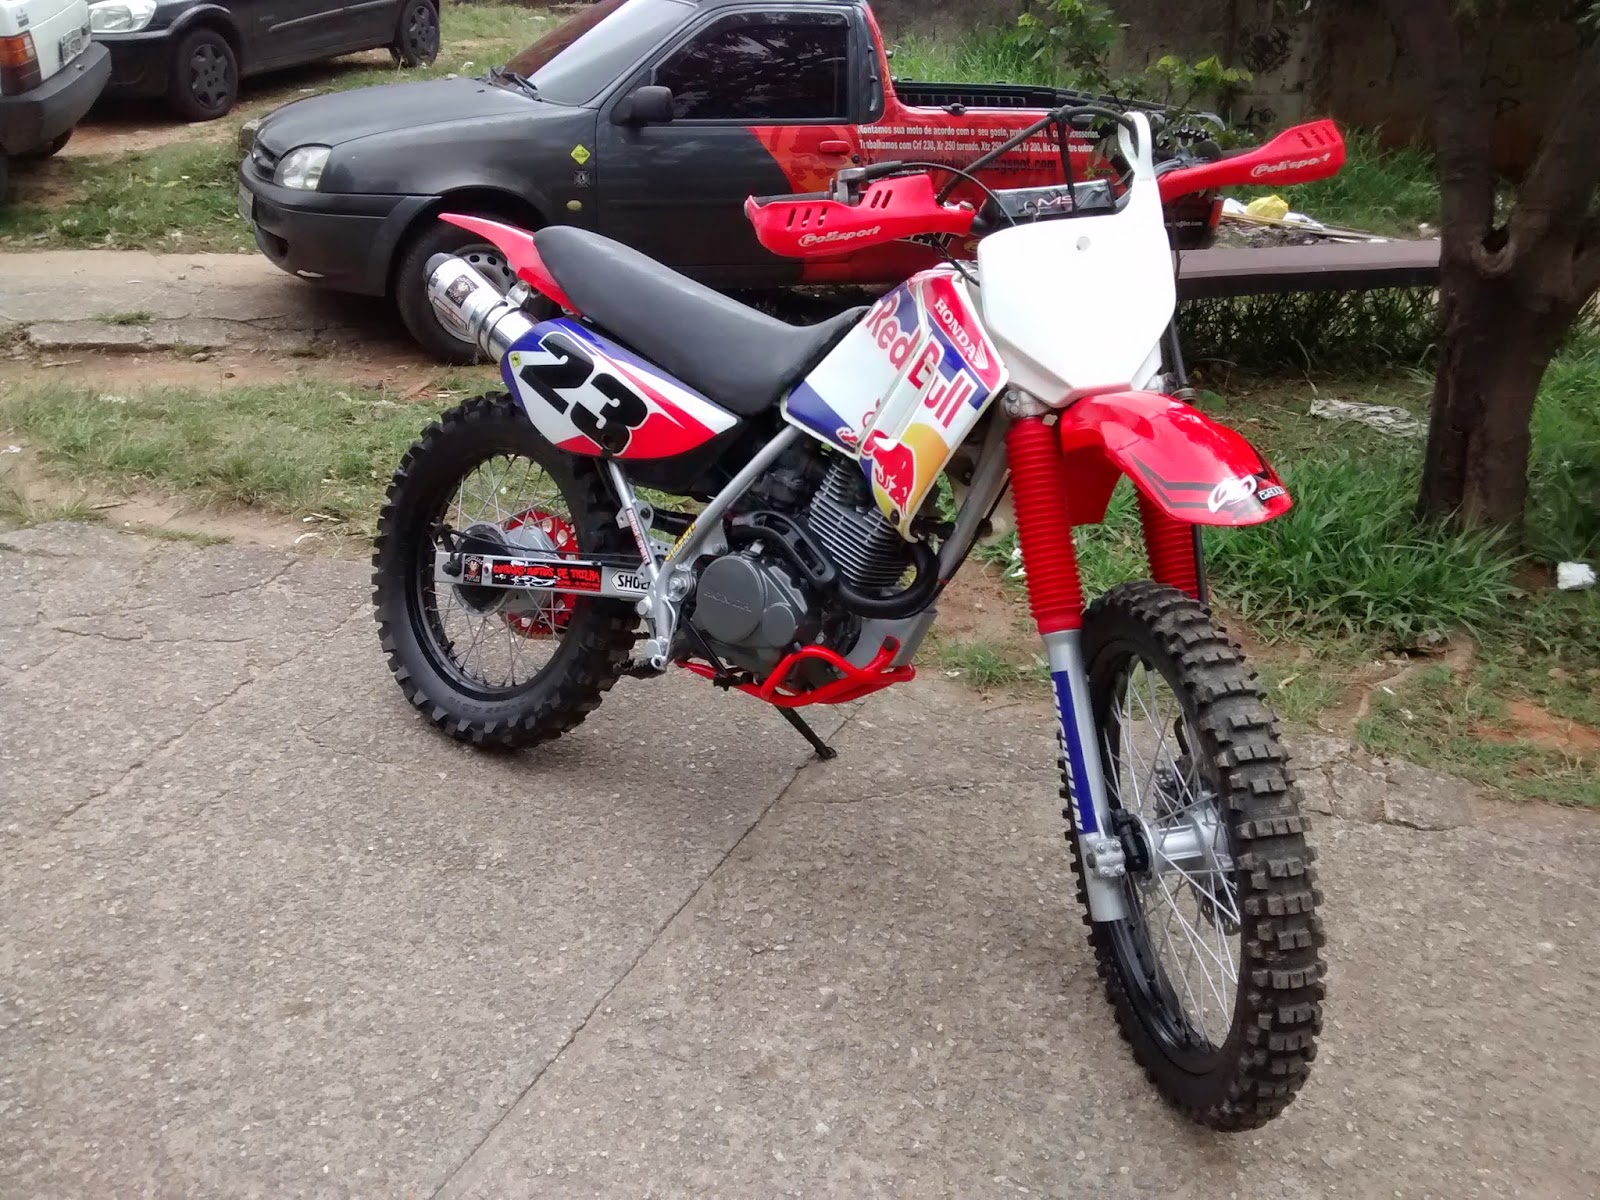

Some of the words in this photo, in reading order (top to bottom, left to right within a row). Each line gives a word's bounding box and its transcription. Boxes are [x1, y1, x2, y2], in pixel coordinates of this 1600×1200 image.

[858, 125, 892, 135] Montamos
[893, 126, 905, 135] sua
[906, 125, 923, 135] moto
[923, 125, 932, 135] de
[933, 126, 955, 136] acordo
[956, 128, 969, 136] com
[978, 128, 989, 137] seu
[859, 139, 898, 149] Trabalhamos
[899, 141, 911, 150] com
[799, 225, 881, 247] Polisport
[933, 298, 977, 363] HONDA
[866, 291, 922, 371] Red
[908, 333, 972, 429] Bull
[518, 331, 649, 455] 23
[557, 567, 569, 579] DE
[570, 568, 600, 583] TRILHA
[617, 574, 650, 590] SHOE
